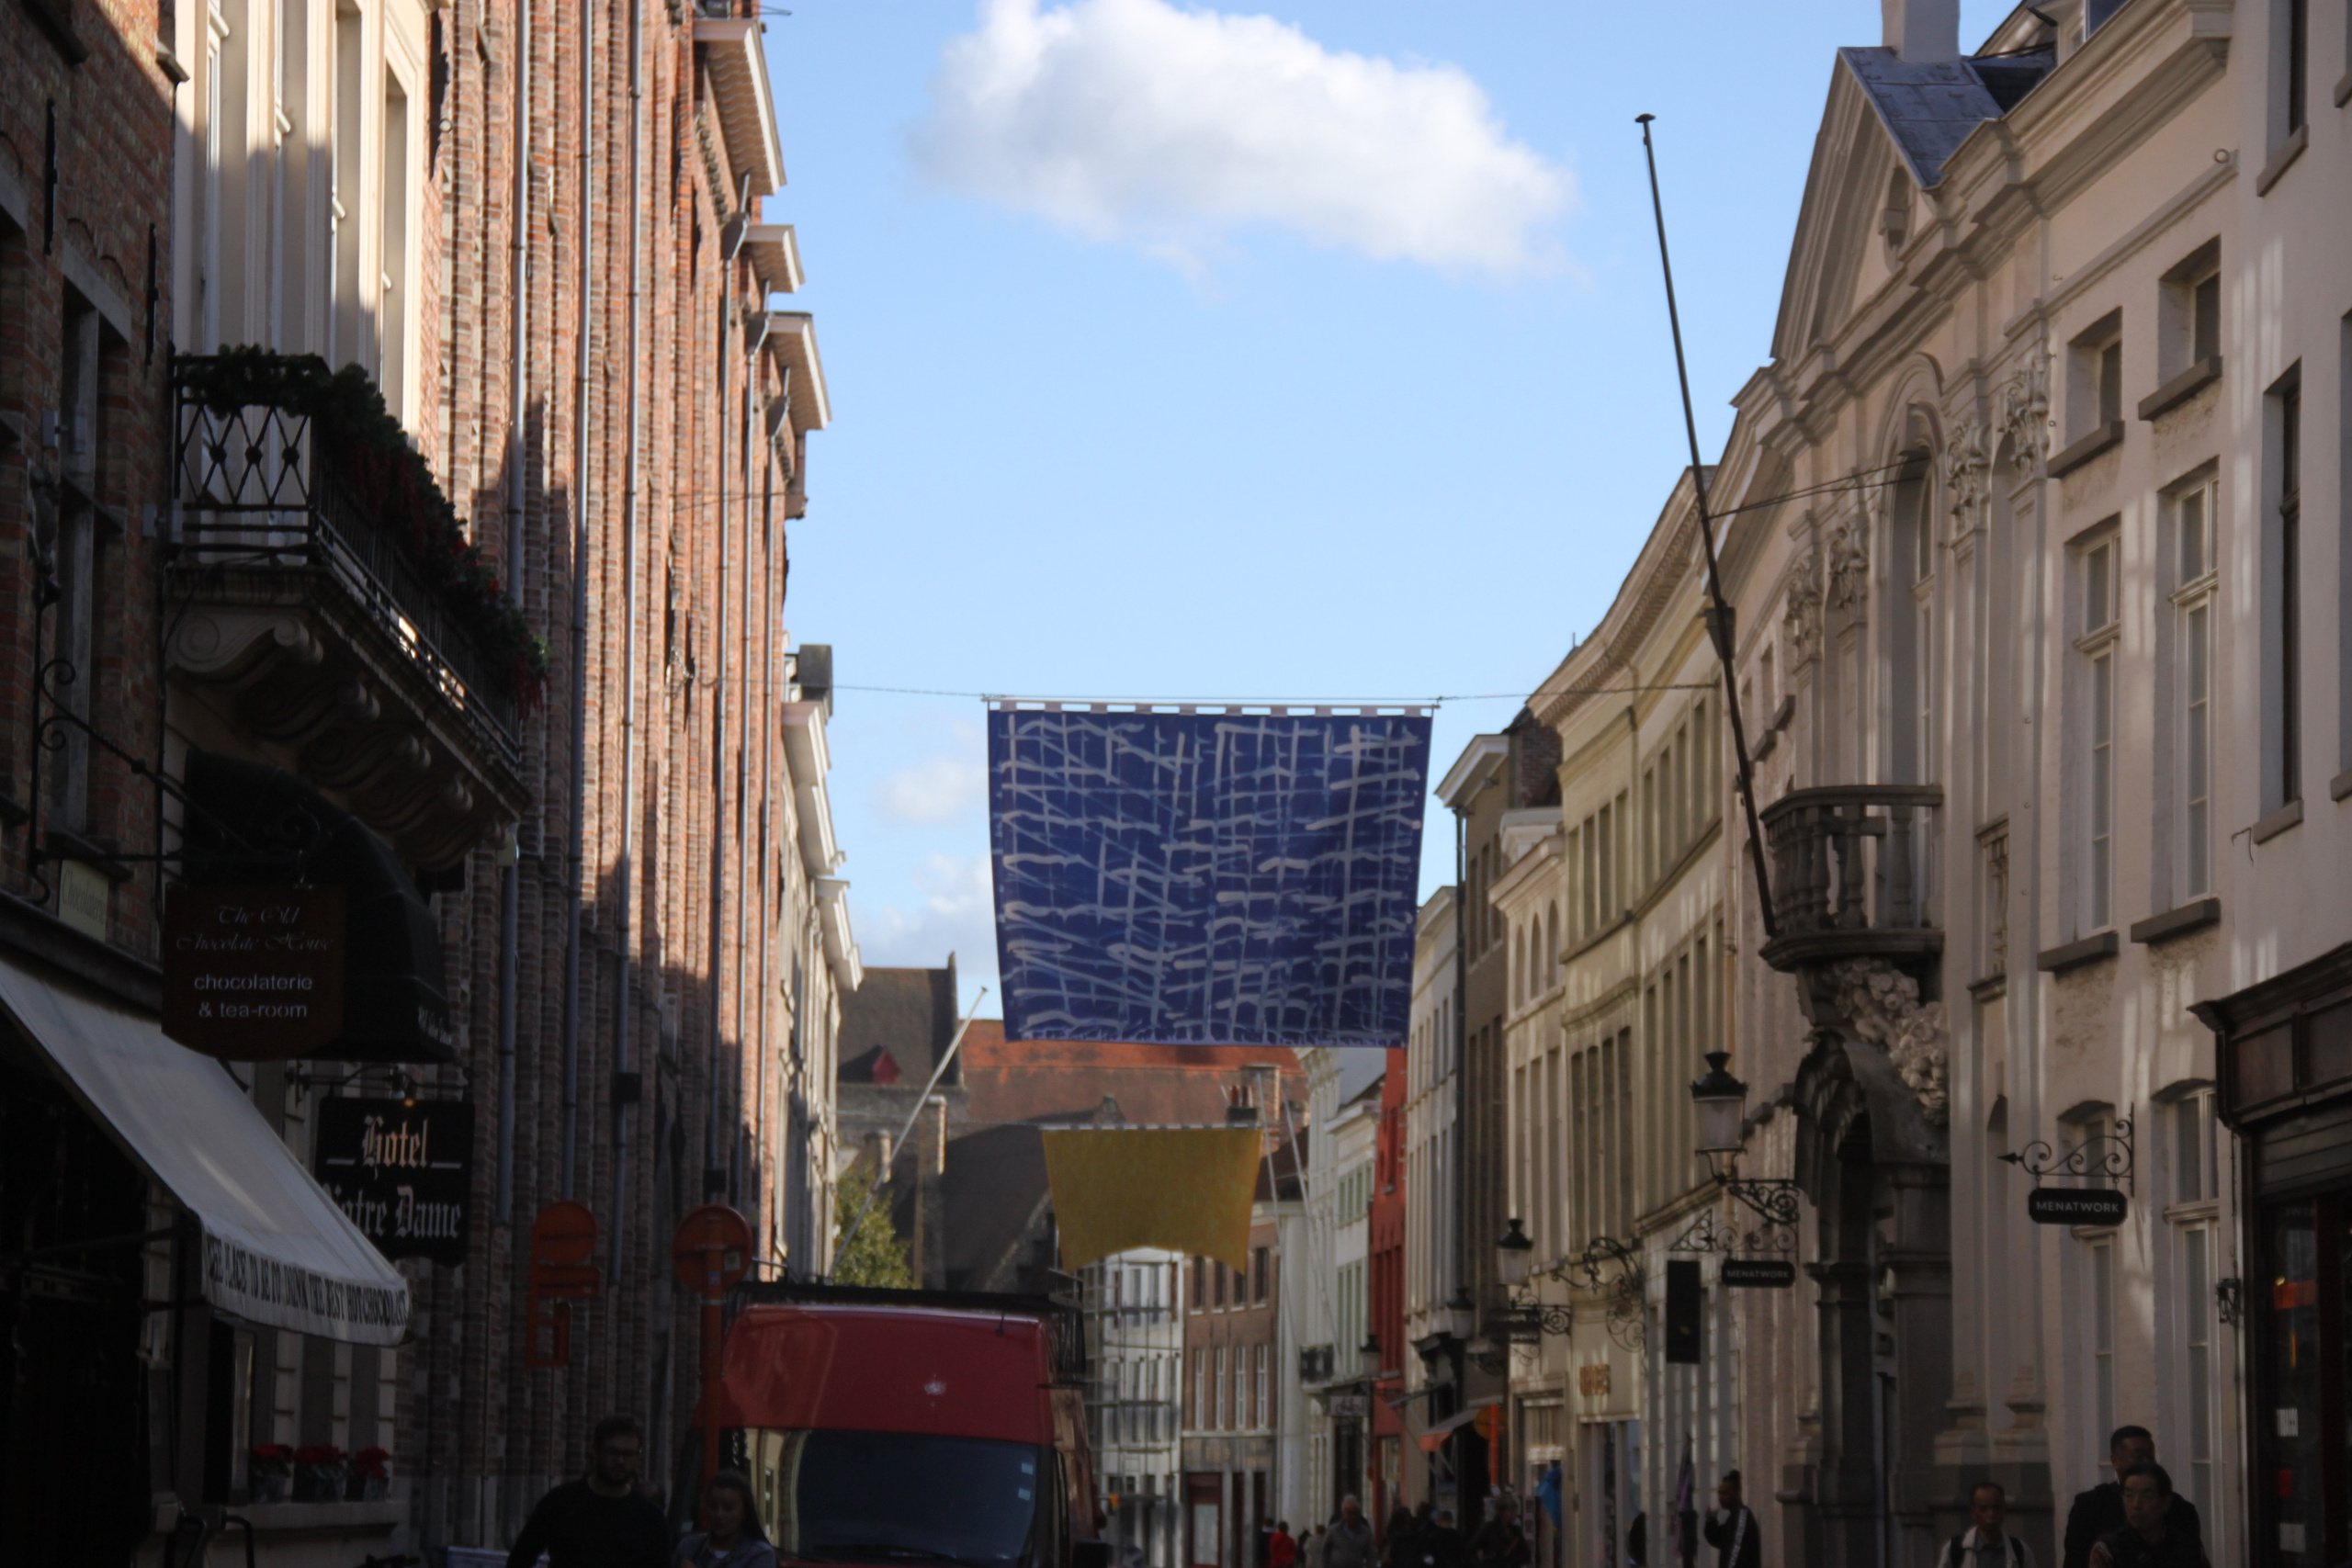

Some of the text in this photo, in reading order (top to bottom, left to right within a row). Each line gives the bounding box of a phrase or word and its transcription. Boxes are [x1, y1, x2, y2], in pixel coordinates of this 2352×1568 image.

[216, 904, 302, 925] The Old
[175, 931, 334, 953] Chocolate House
[193, 973, 314, 991] chocolaterie
[198, 1001, 309, 1019] & tea-room
[362, 1113, 430, 1181] Hotel
[323, 1183, 463, 1240] otre Dame
[2035, 1200, 2120, 1213] MENATWORK
[1725, 1269, 1791, 1279] MENATWORK
